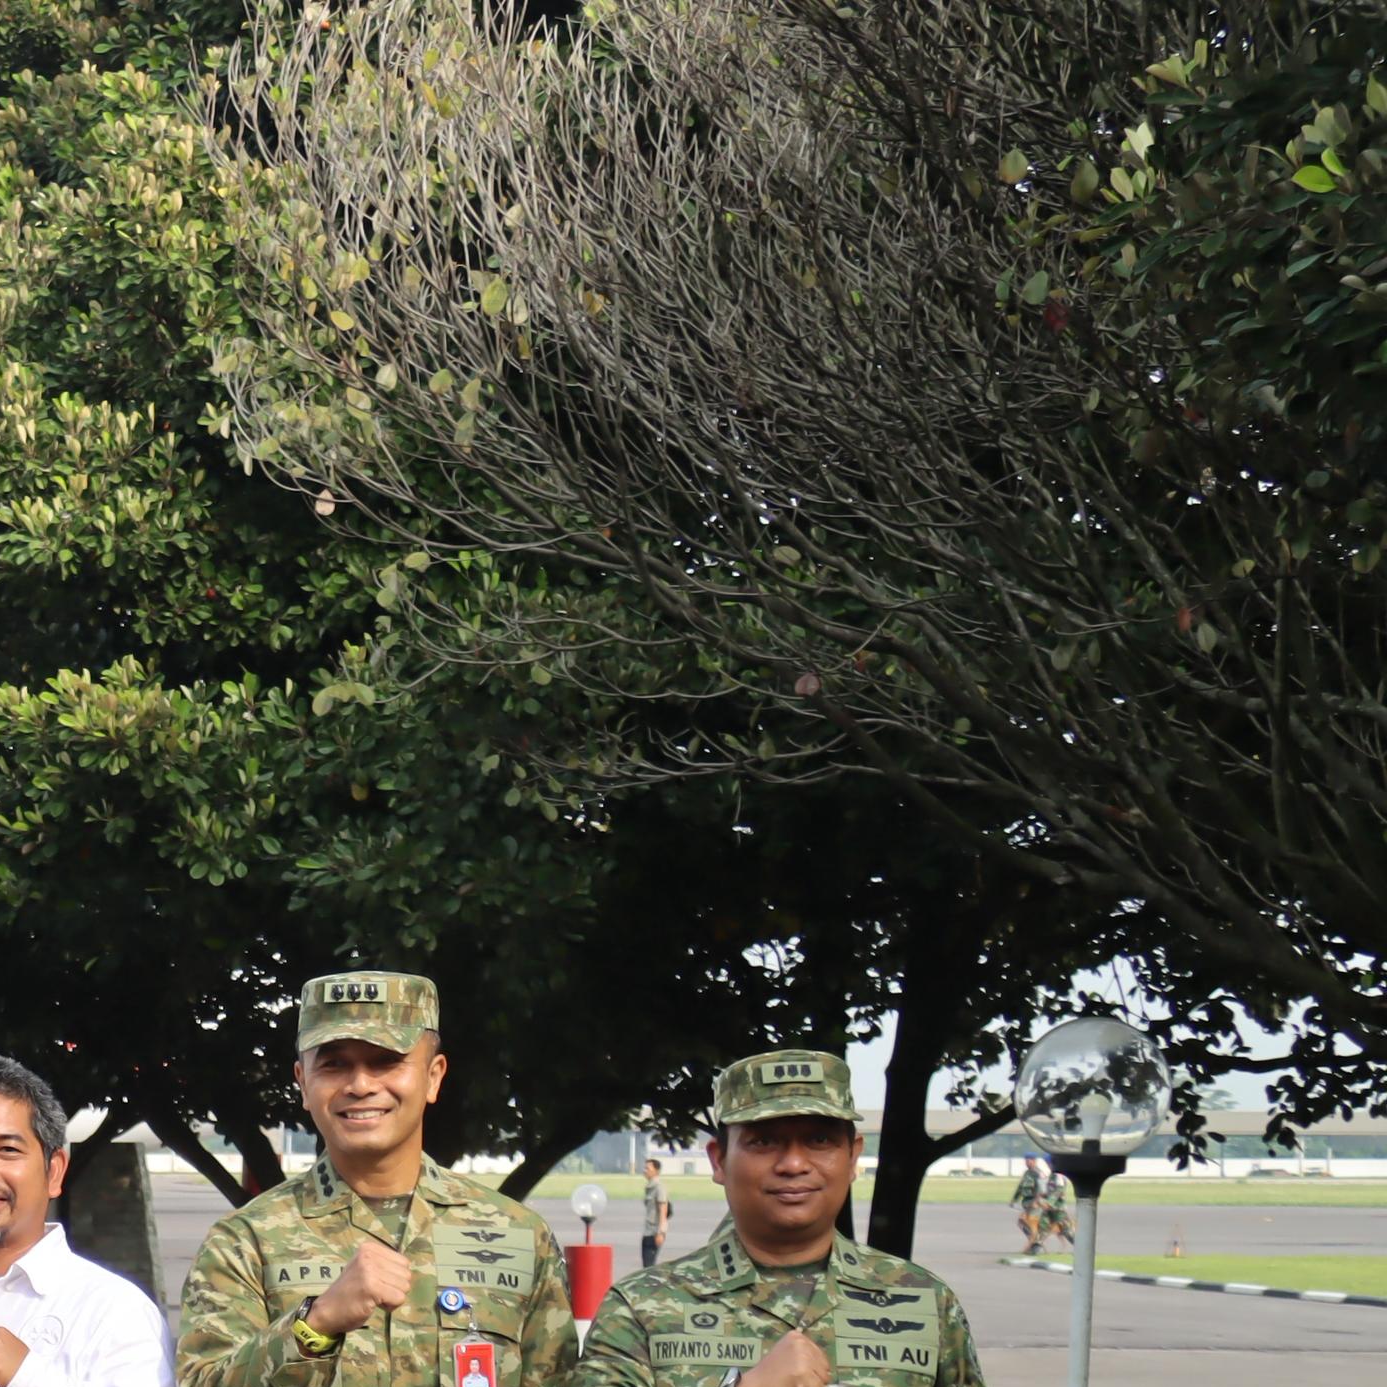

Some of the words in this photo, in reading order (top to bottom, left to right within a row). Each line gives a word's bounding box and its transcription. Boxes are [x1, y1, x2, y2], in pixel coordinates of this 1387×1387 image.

[455, 1269, 486, 1283] TNI
[497, 1273, 519, 1288] AU
[655, 1341, 711, 1360] TRIYANTO
[716, 1342, 755, 1361] SANDY
[848, 1344, 888, 1361] TNI
[900, 1347, 929, 1367] AU
